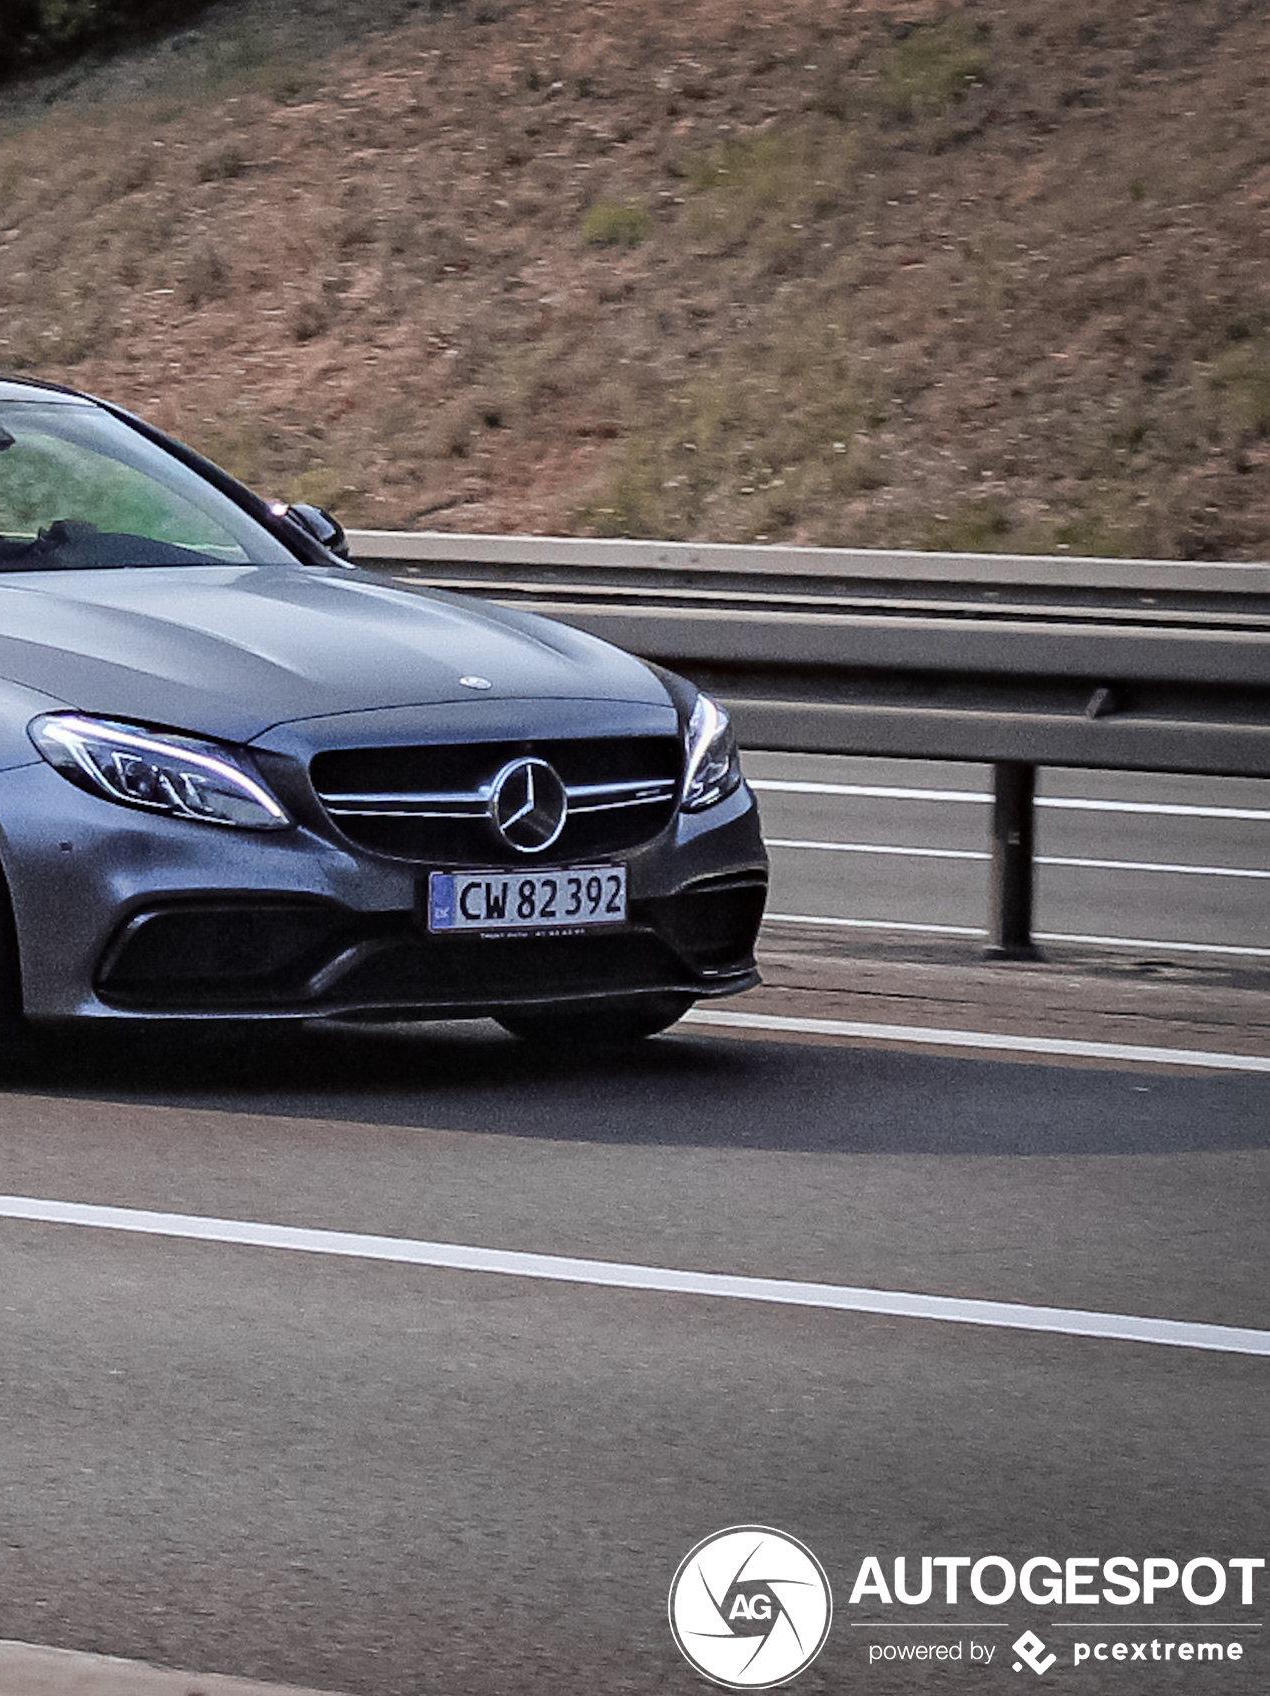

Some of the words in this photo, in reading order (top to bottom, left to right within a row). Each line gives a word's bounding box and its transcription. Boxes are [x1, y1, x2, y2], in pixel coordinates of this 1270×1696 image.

[459, 881, 509, 920] CW
[517, 879, 558, 919] 82
[565, 875, 622, 915] 392
